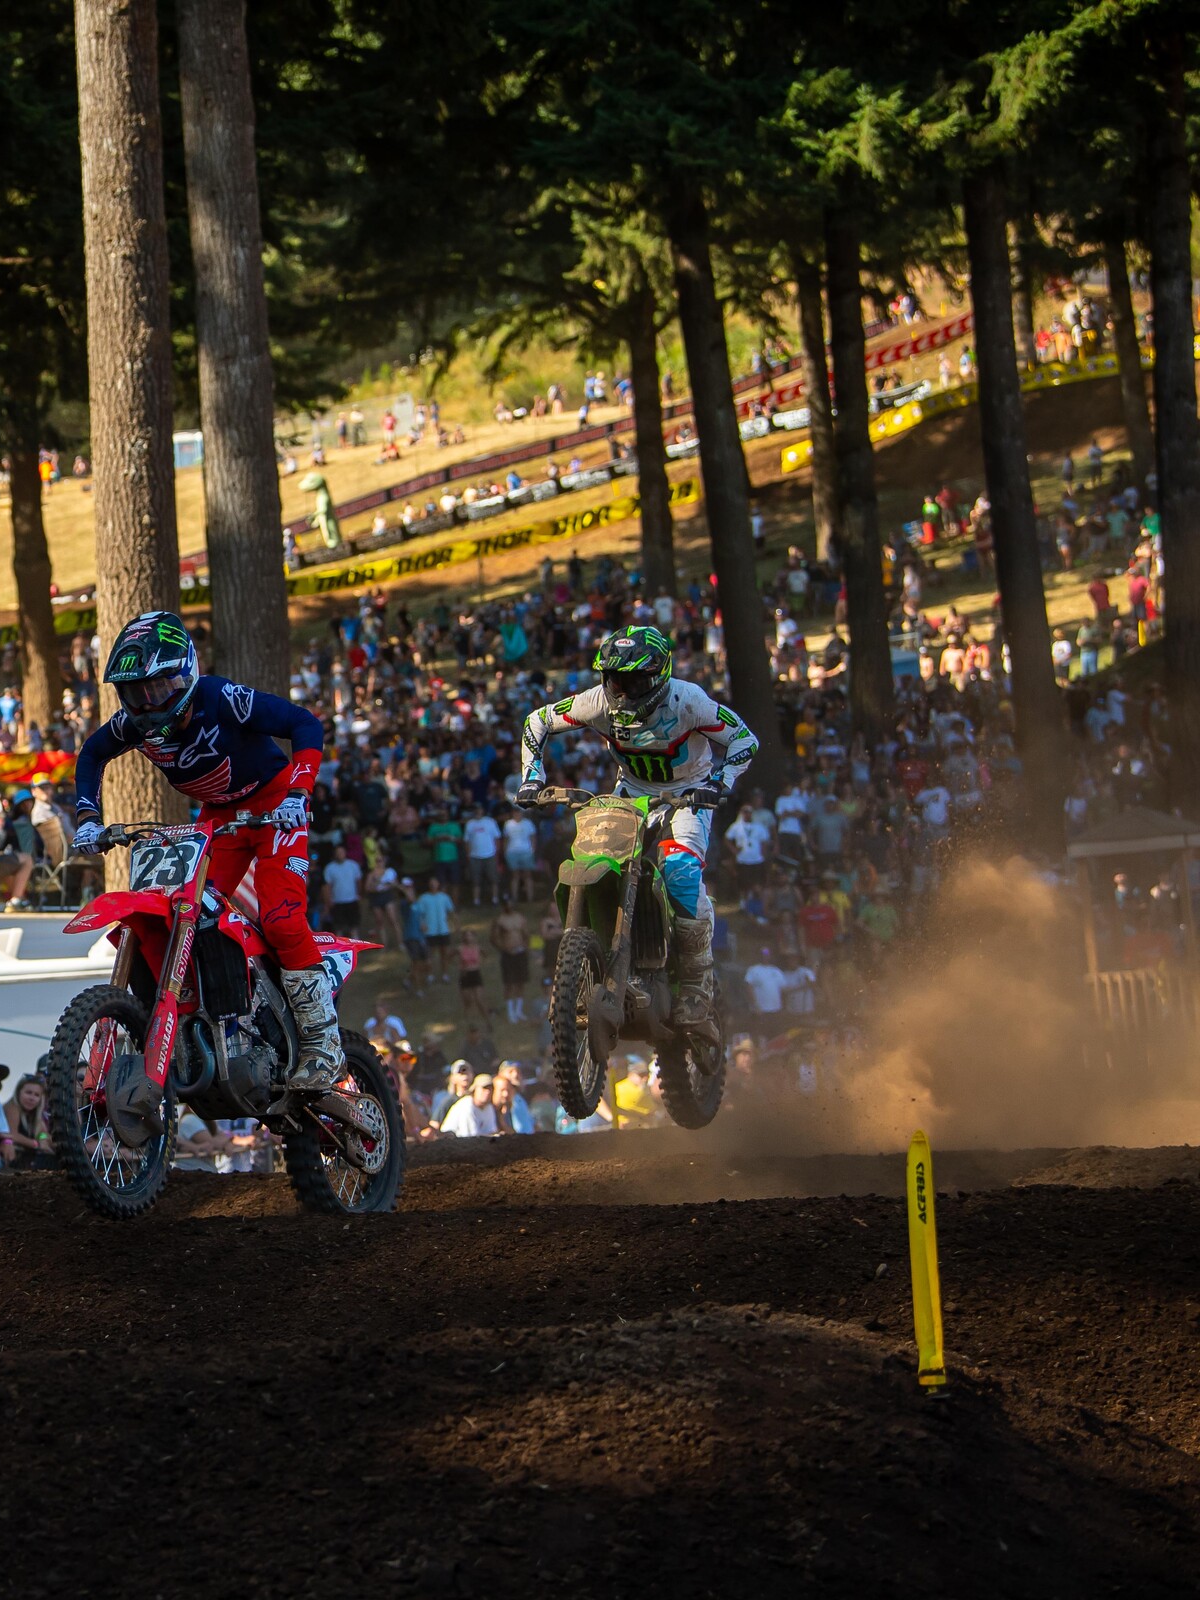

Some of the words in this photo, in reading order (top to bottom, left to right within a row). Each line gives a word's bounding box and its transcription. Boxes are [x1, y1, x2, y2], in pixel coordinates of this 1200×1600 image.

[553, 505, 610, 534] THOR
[475, 528, 533, 556] THOR
[398, 548, 454, 574] THOR
[317, 567, 375, 592] THOR
[132, 844, 195, 890] 23
[156, 1012, 174, 1075] DUNLOP
[915, 1162, 927, 1224] ACERBIS
